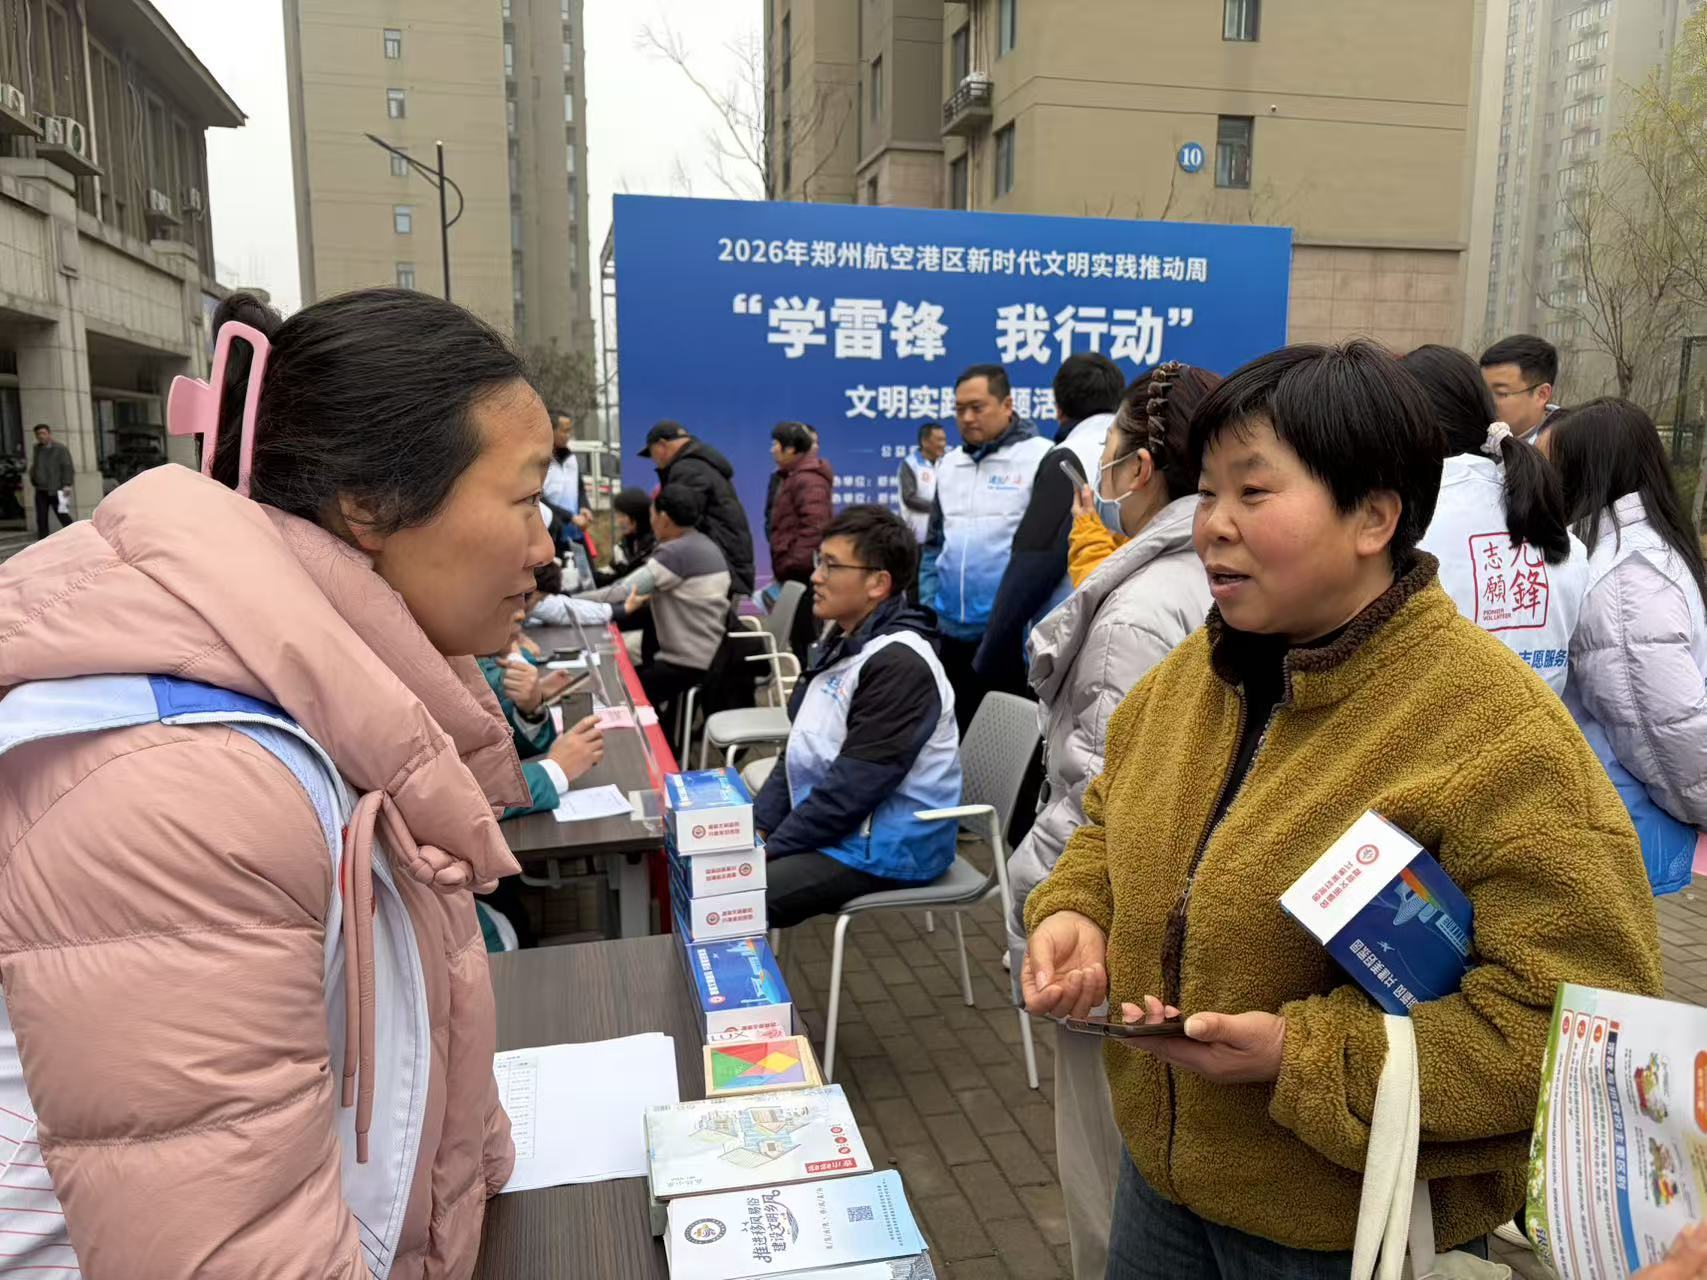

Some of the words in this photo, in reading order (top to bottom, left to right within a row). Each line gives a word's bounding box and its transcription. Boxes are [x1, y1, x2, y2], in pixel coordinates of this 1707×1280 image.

[1183, 147, 1202, 167] 10
[718, 238, 1208, 283] 2026年郑州航空港区新时代文明实践推动周
[733, 294, 948, 362] “学雷锋
[996, 305, 1194, 366] 我行动”
[1349, 938, 1397, 987] 共建美好家园
[747, 1197, 774, 1264] 推进移风易俗
